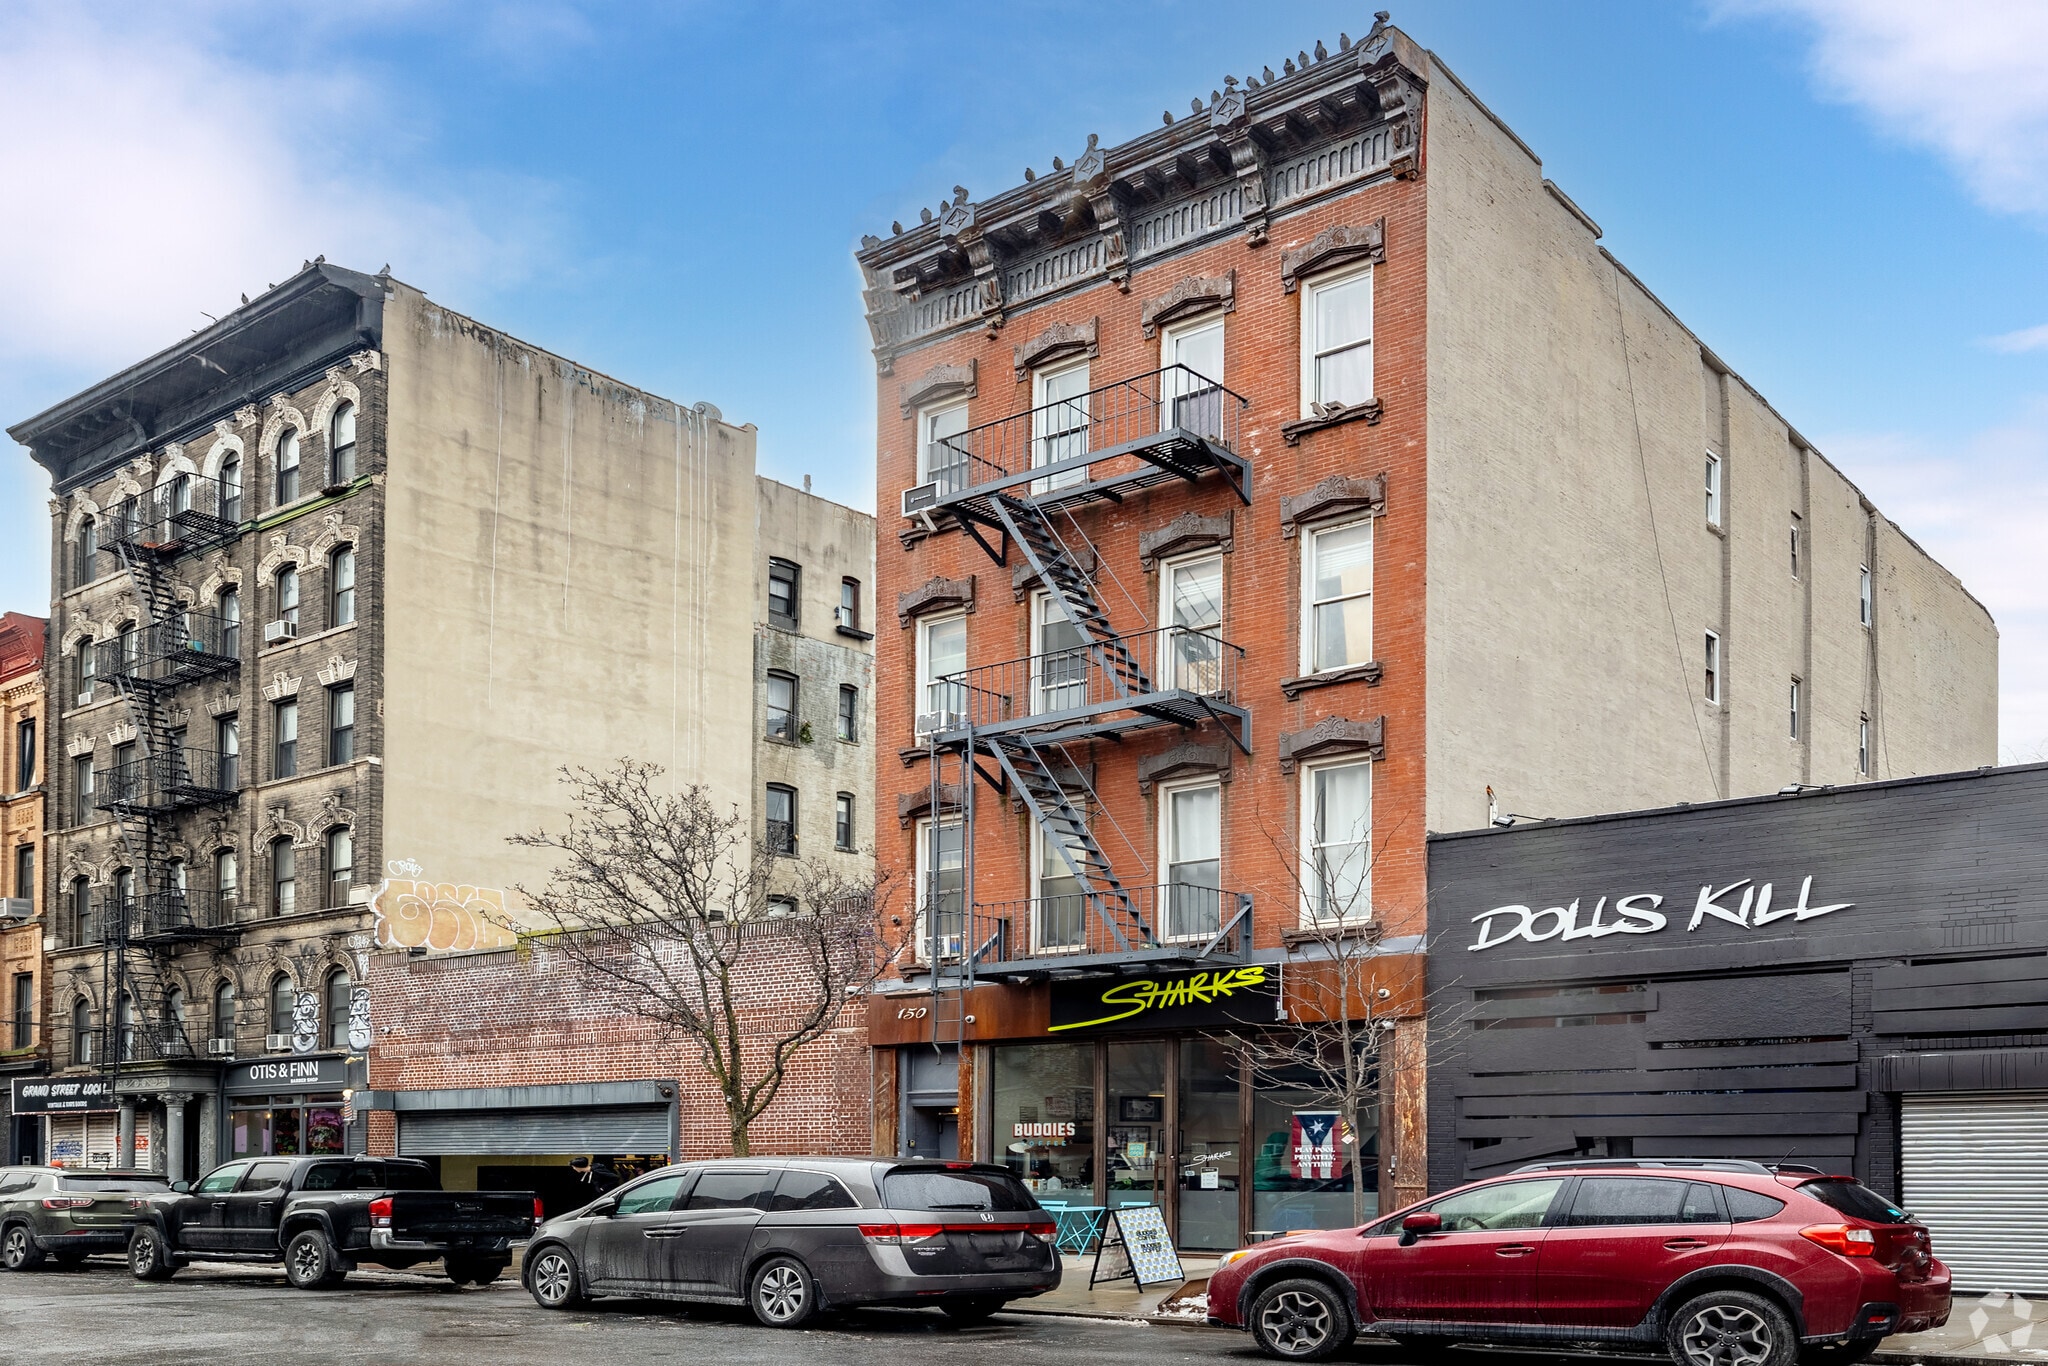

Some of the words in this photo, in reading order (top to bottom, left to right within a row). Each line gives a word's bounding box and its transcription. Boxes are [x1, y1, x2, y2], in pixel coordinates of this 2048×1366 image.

[1467, 893, 1668, 951] DOLLS
[1687, 874, 1856, 932] KILL
[1047, 966, 1266, 1032] SHARKS
[897, 1007, 928, 1020] 150
[250, 1064, 277, 1080] OTIS
[278, 1062, 288, 1078] &
[290, 1060, 319, 1078] FINN
[22, 1084, 50, 1098] GRAND
[50, 1083, 81, 1097] STREET
